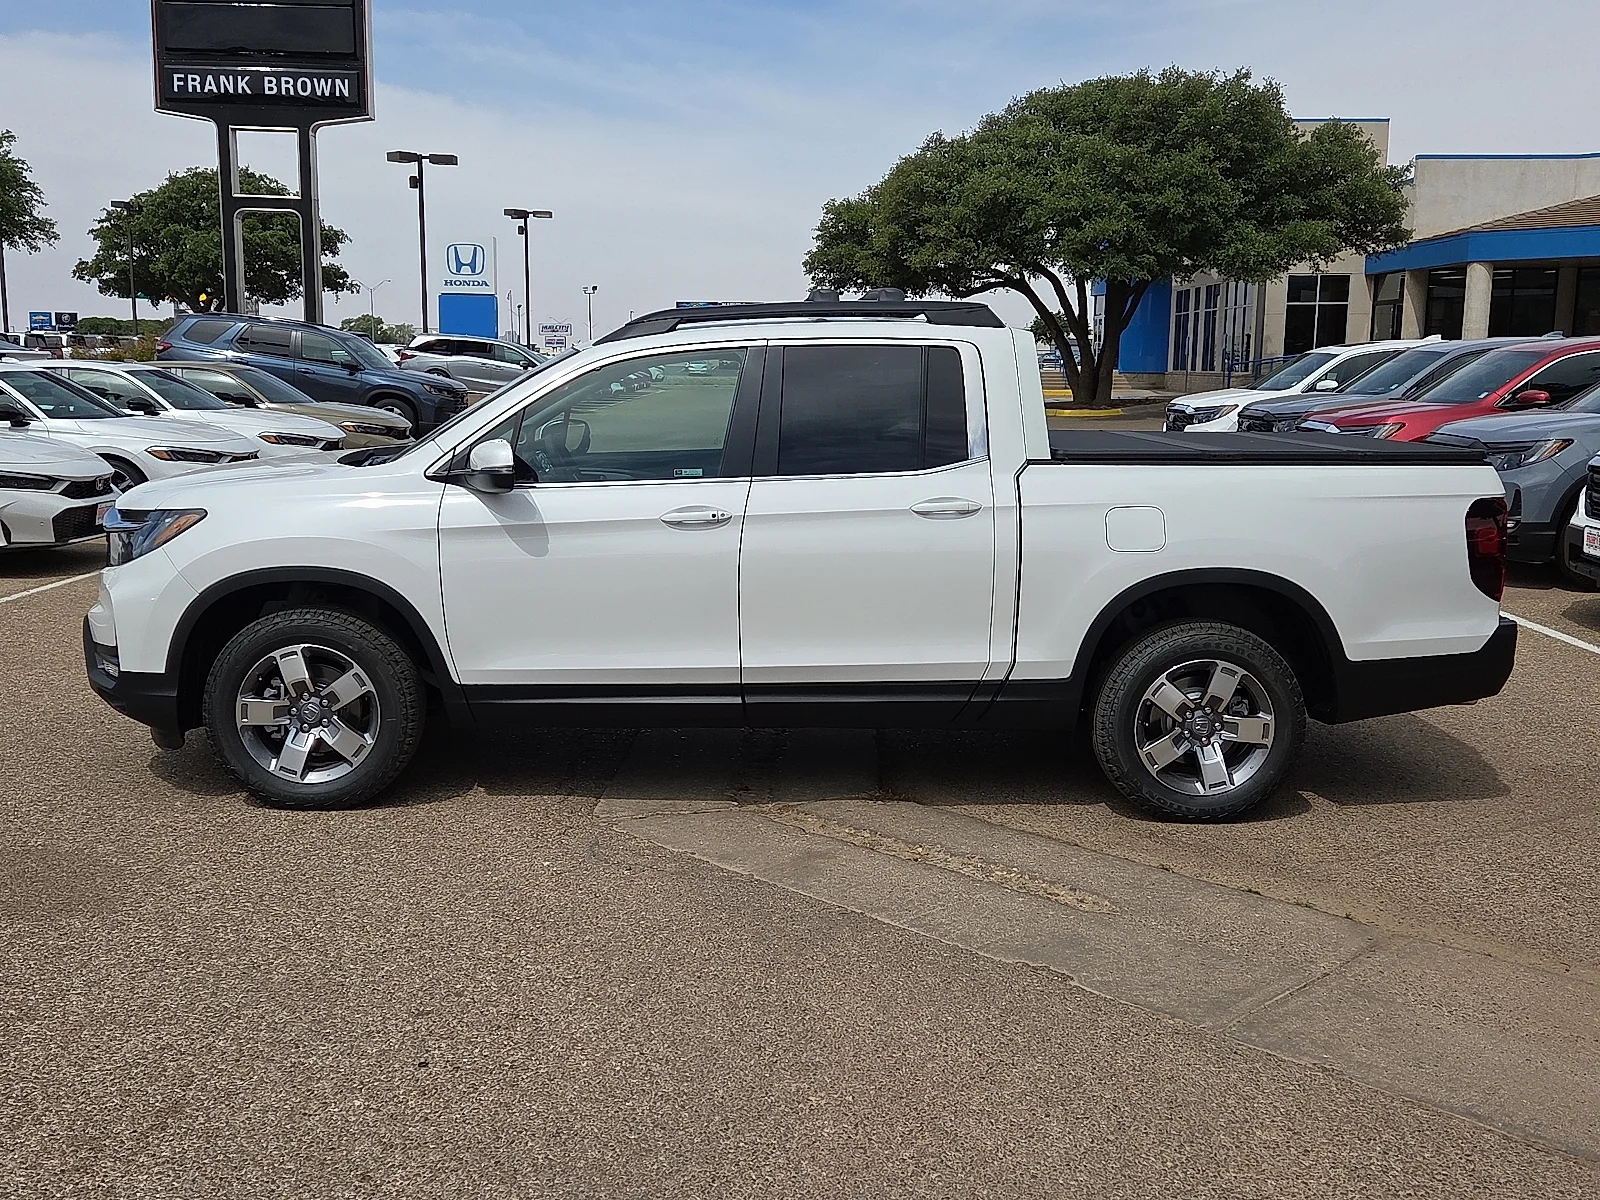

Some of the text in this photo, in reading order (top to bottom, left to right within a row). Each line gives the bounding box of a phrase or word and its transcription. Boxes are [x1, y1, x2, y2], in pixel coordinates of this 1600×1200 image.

[172, 73, 350, 97] FRANK BROWN
[443, 279, 490, 287] HONDA
